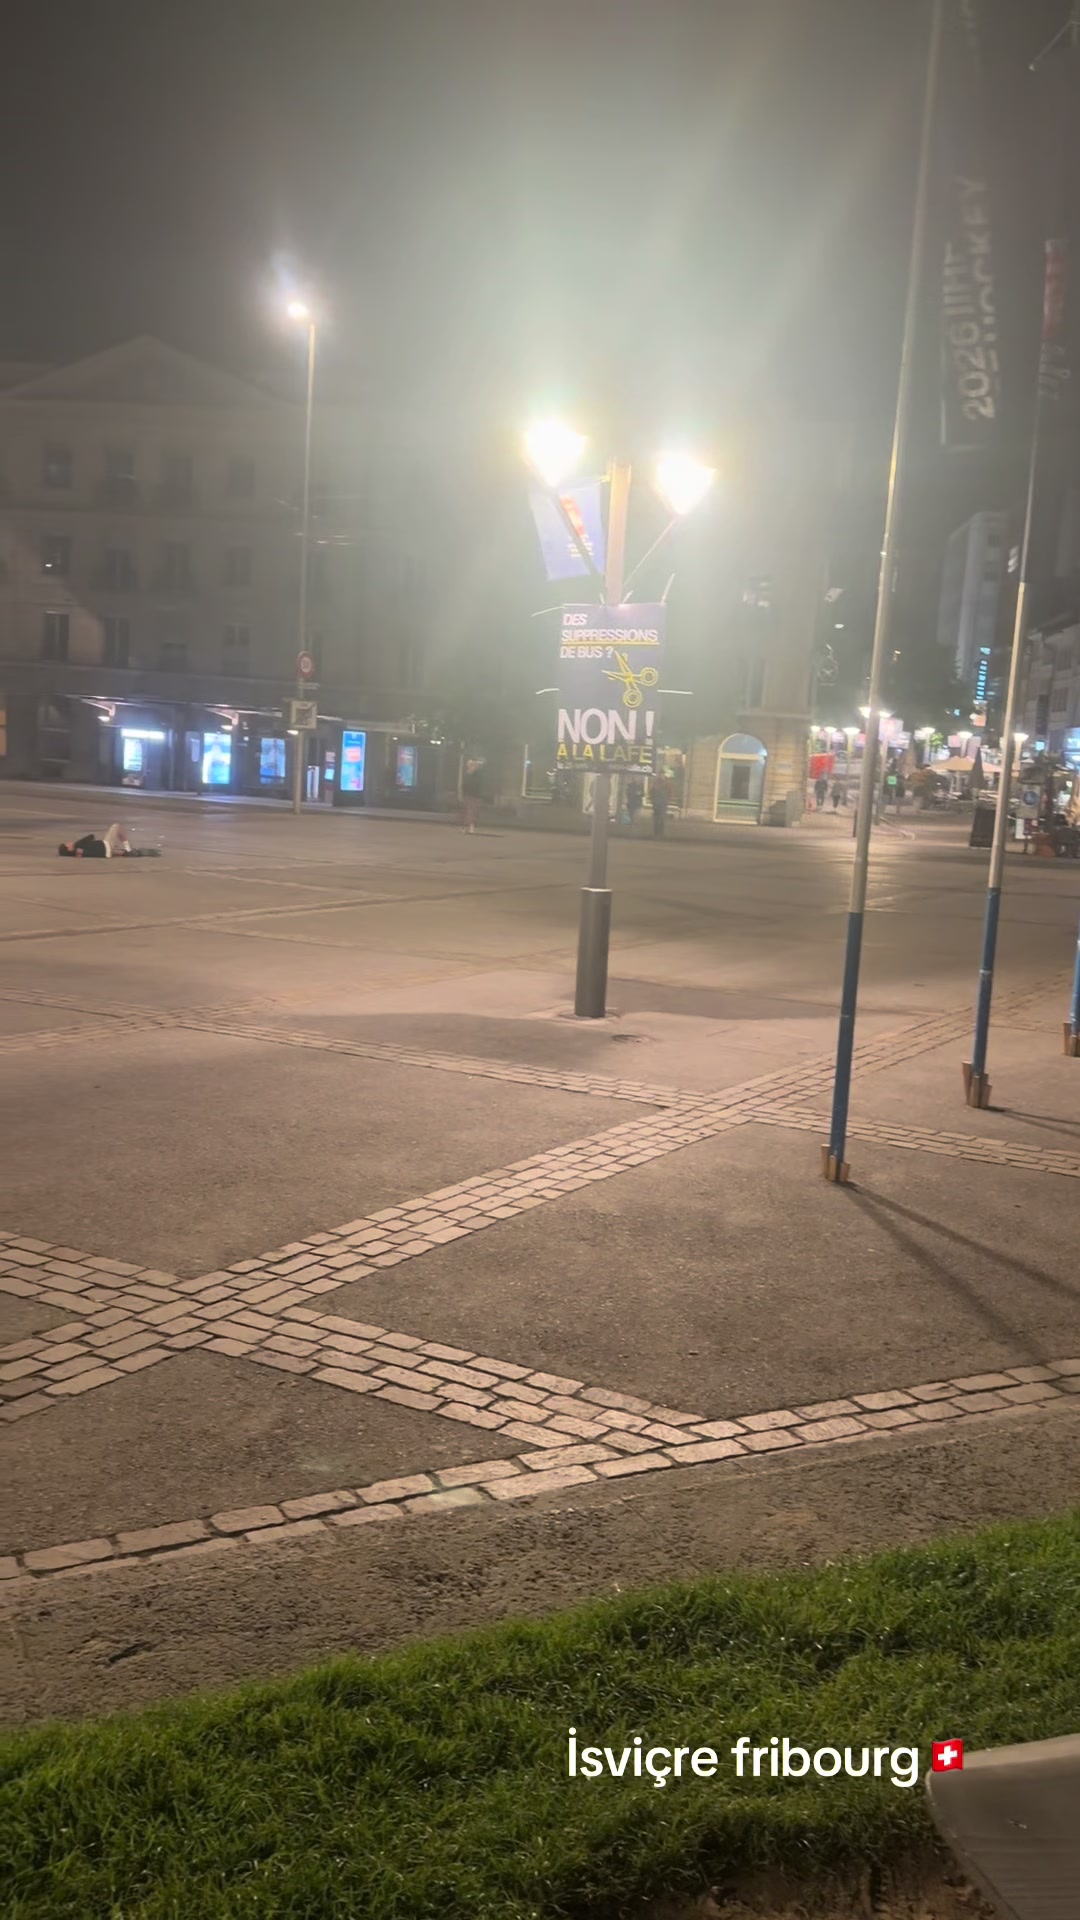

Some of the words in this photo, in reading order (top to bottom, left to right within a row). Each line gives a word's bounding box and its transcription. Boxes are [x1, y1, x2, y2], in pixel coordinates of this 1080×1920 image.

[950, 321, 996, 421] 2026
[562, 613, 588, 626] DES
[561, 629, 658, 642] SUPPRESSIONS
[560, 646, 576, 659] DE
[577, 646, 603, 659] BUS
[557, 708, 637, 745] NON
[645, 710, 655, 745] !
[572, 744, 594, 761] LA
